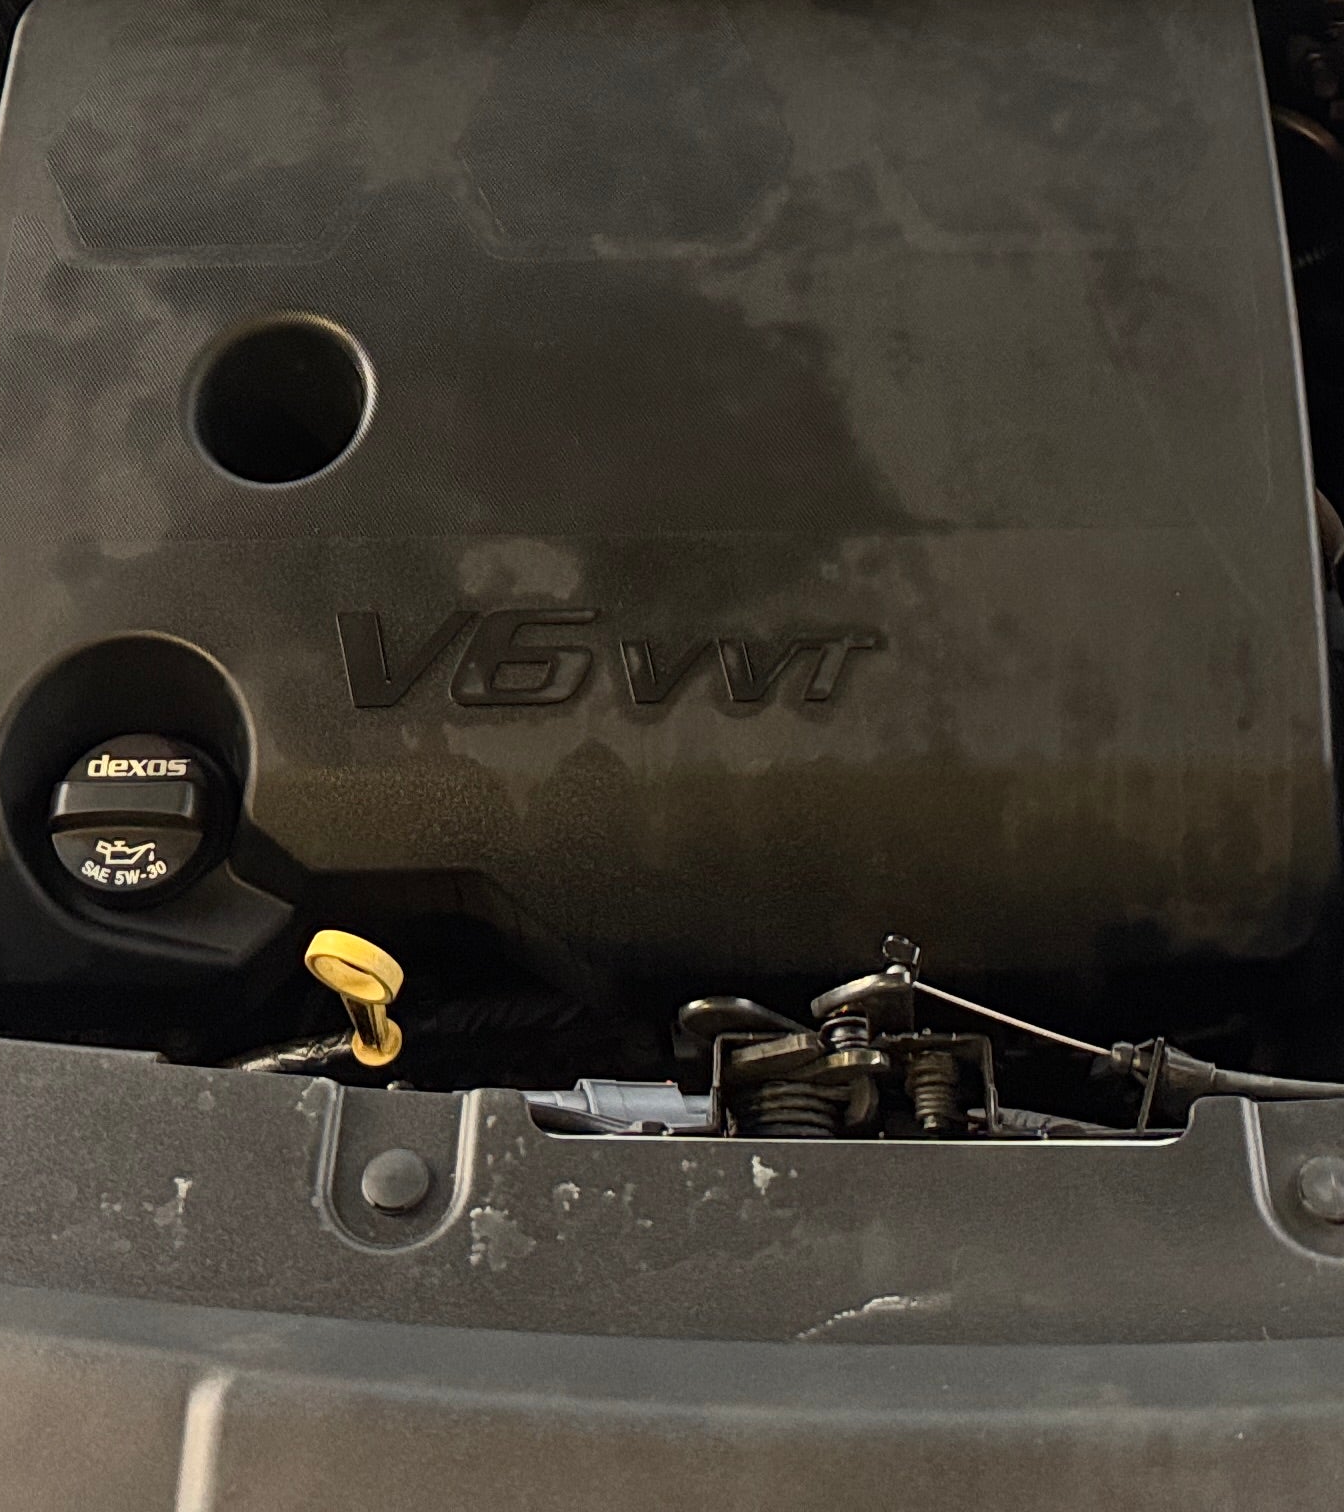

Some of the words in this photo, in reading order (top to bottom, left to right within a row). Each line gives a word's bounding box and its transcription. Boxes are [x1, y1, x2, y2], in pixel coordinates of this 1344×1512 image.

[336, 608, 599, 708] V6
[620, 631, 882, 705] VVT
[87, 755, 190, 777] dexos
[81, 860, 111, 884] SAE
[114, 860, 167, 885] 5W-30
